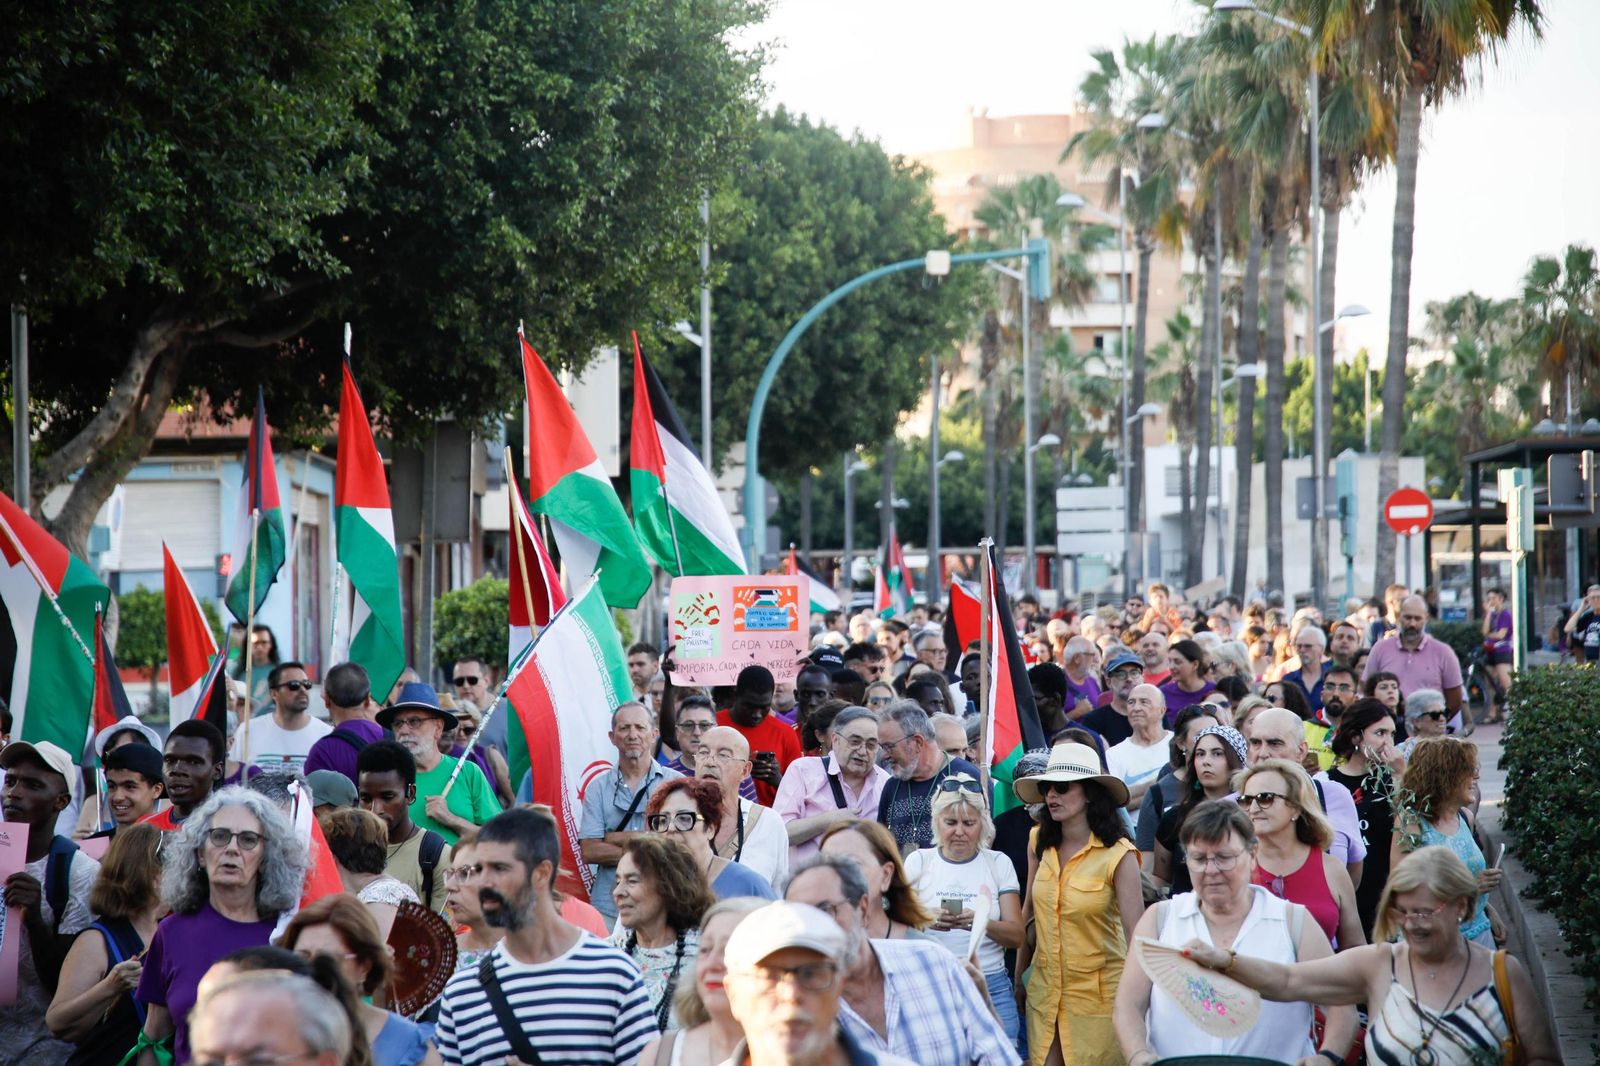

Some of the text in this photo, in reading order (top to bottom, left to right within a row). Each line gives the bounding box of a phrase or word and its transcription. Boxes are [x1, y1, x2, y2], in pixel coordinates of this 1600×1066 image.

[731, 639, 794, 650] CADA VIDA
[718, 661, 737, 671] CADA
[767, 659, 794, 670] MERECE
[777, 670, 793, 679] PAZ
